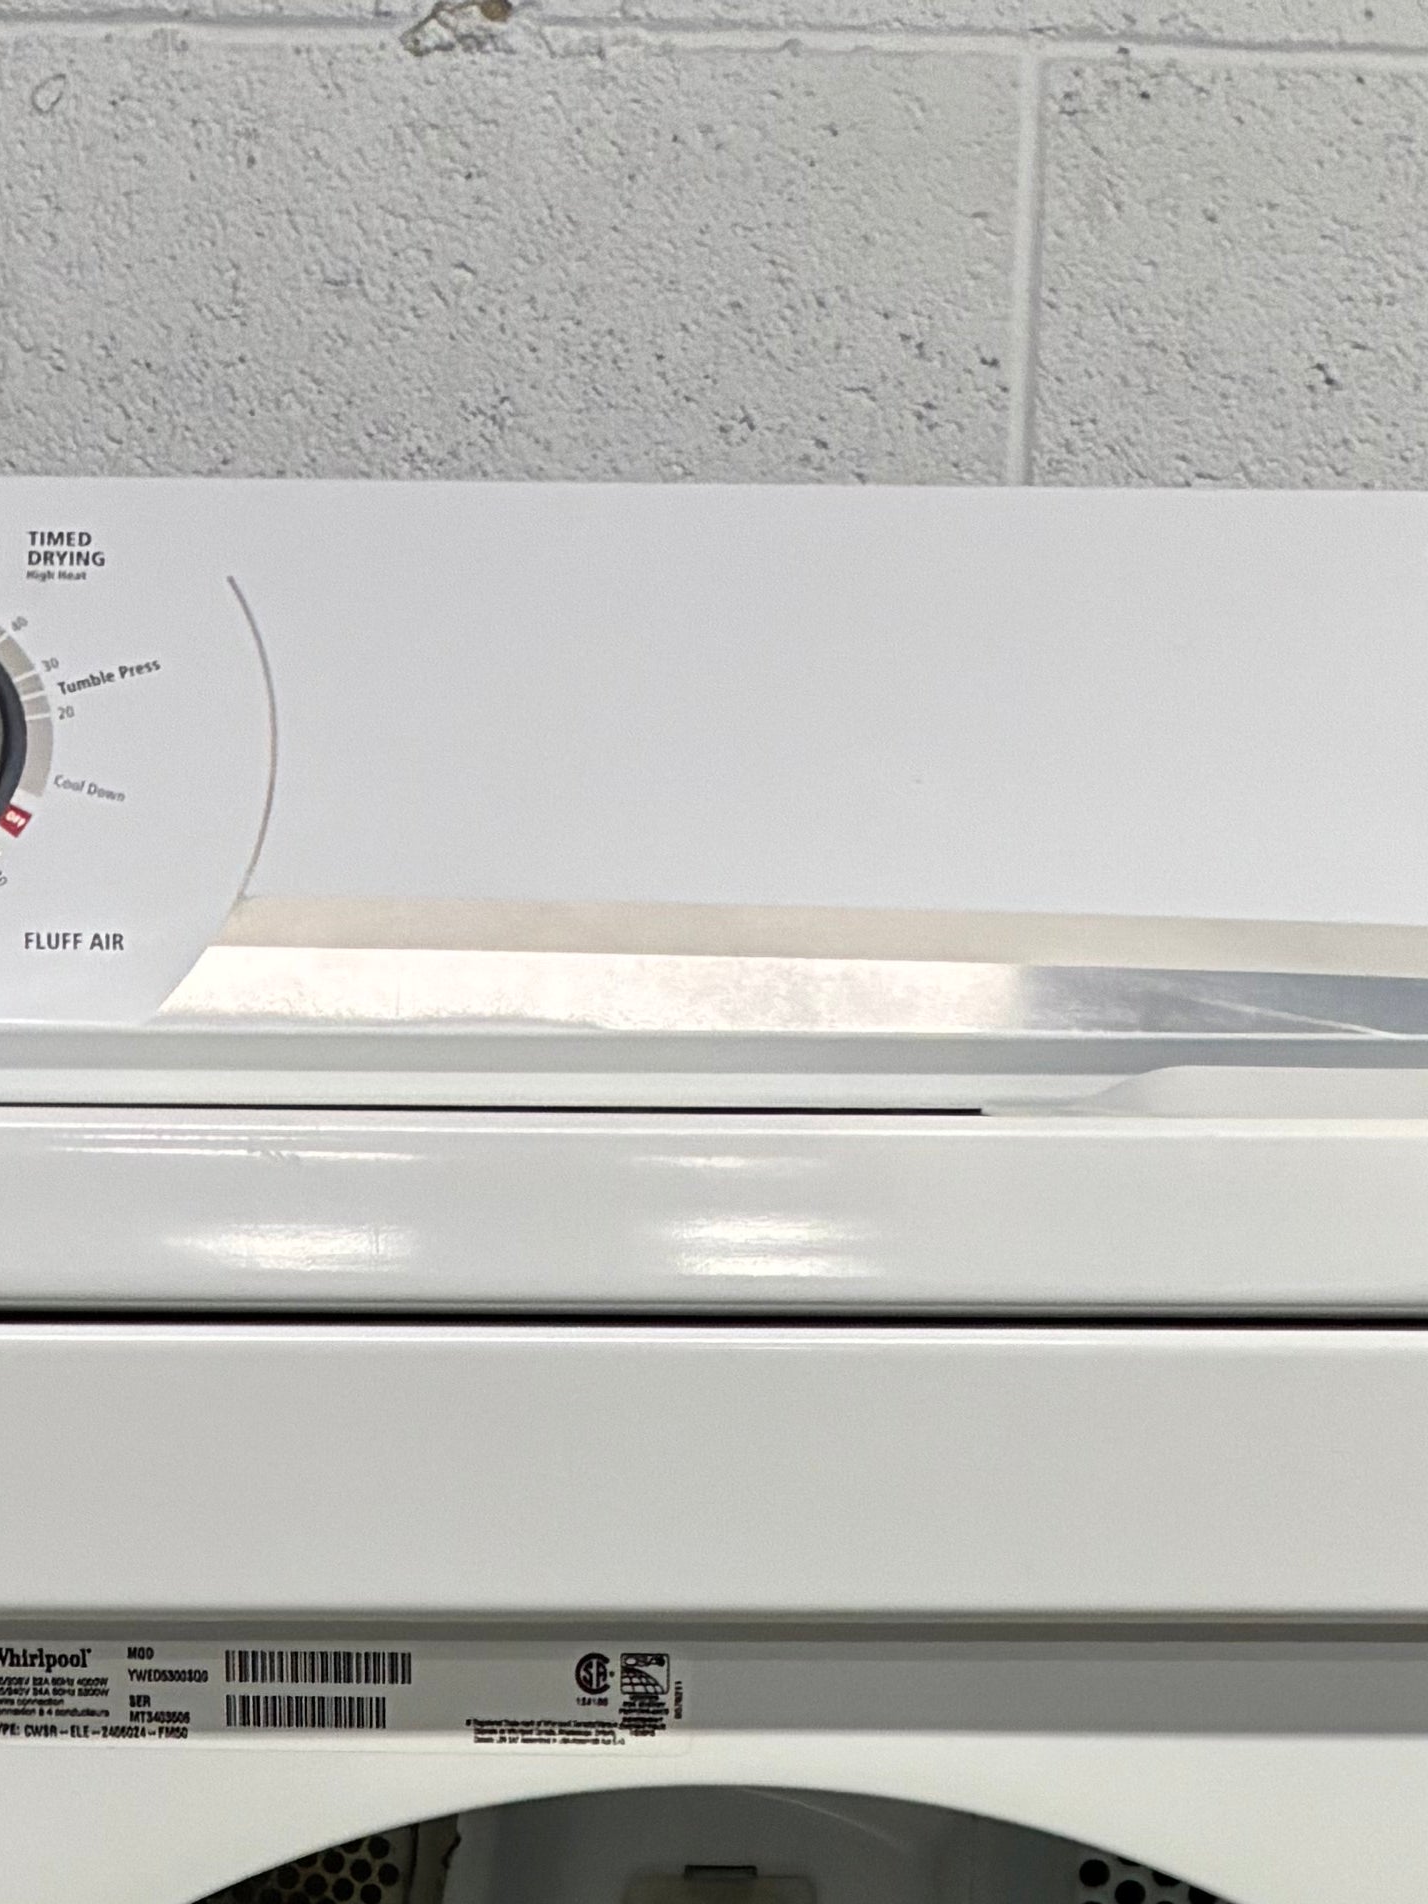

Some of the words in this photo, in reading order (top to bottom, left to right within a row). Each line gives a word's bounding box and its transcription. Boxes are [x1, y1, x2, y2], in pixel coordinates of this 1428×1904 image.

[28, 531, 92, 547] TIMED
[27, 550, 106, 567] DRYING
[26, 570, 55, 582] High
[58, 570, 87, 580] Heat
[11, 615, 28, 632] 40
[41, 658, 59, 672] 30
[57, 670, 116, 695] Tumble
[118, 660, 161, 680] Press
[58, 705, 75, 720] 20
[53, 774, 85, 792] Cool
[86, 782, 126, 803] Down
[25, 932, 83, 950] FLUFF
[90, 933, 124, 951] AIR
